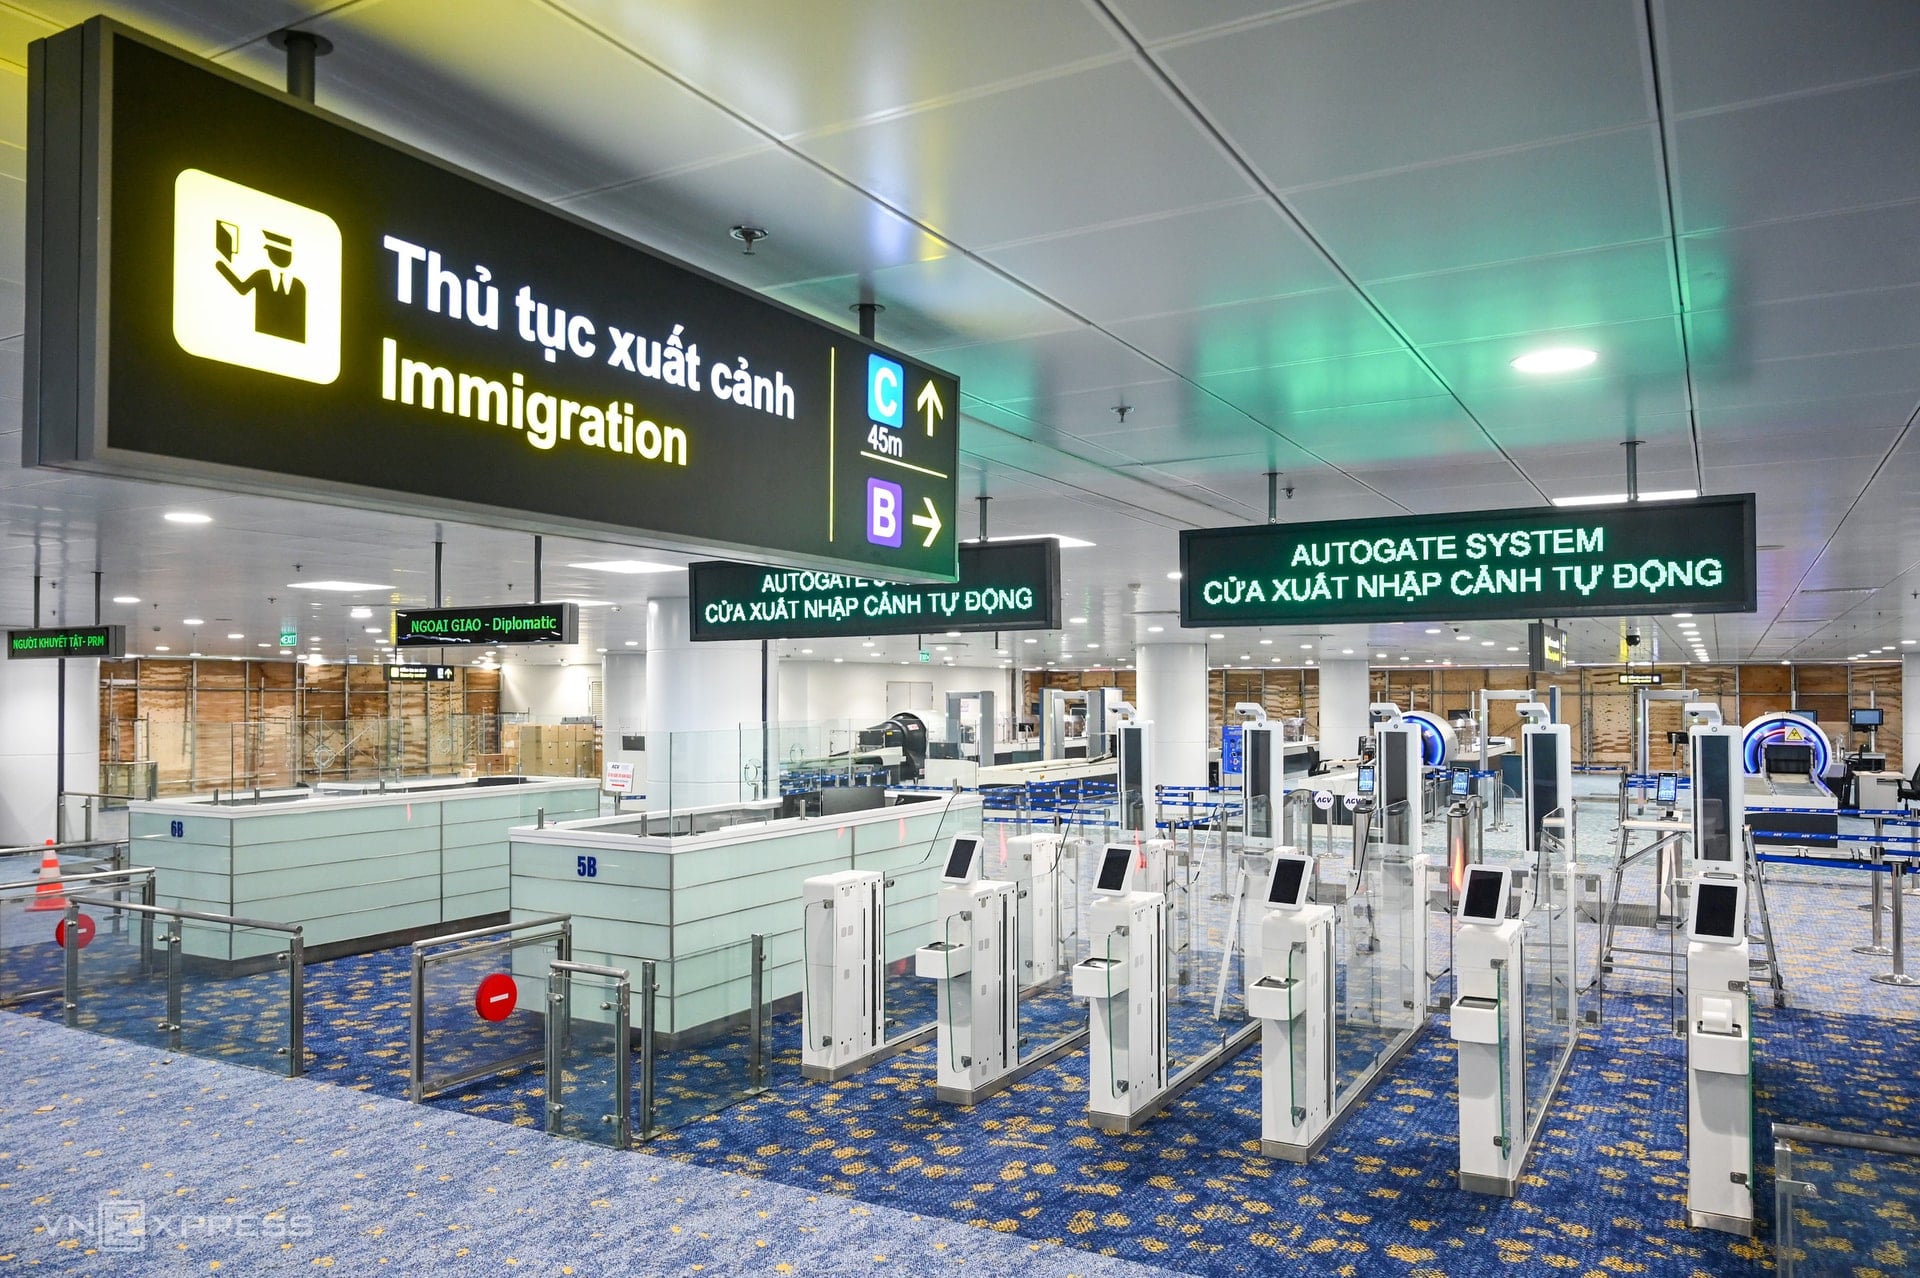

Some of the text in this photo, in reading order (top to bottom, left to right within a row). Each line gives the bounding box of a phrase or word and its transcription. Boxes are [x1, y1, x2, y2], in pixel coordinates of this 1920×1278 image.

[383, 234, 795, 420] Thủ tục xuất cảnh
[382, 337, 687, 466] Immigration
[873, 366, 898, 417] C
[867, 424, 903, 458] 45m
[872, 486, 897, 538] B
[1290, 527, 1604, 567] AUTOGATE SYSTEM
[1203, 558, 1722, 604] CỬA XUẤT NHẬP CẢNH TỰ ĐỘNG
[705, 587, 1033, 623] CỬA XUẤT NHẬP CẢNH TỰ ĐỘNG
[87, 635, 104, 647] PRM
[451, 618, 481, 632] GIAO
[492, 616, 556, 634] Diplomatic
[170, 820, 184, 838] 6B
[577, 855, 597, 877] 5B
